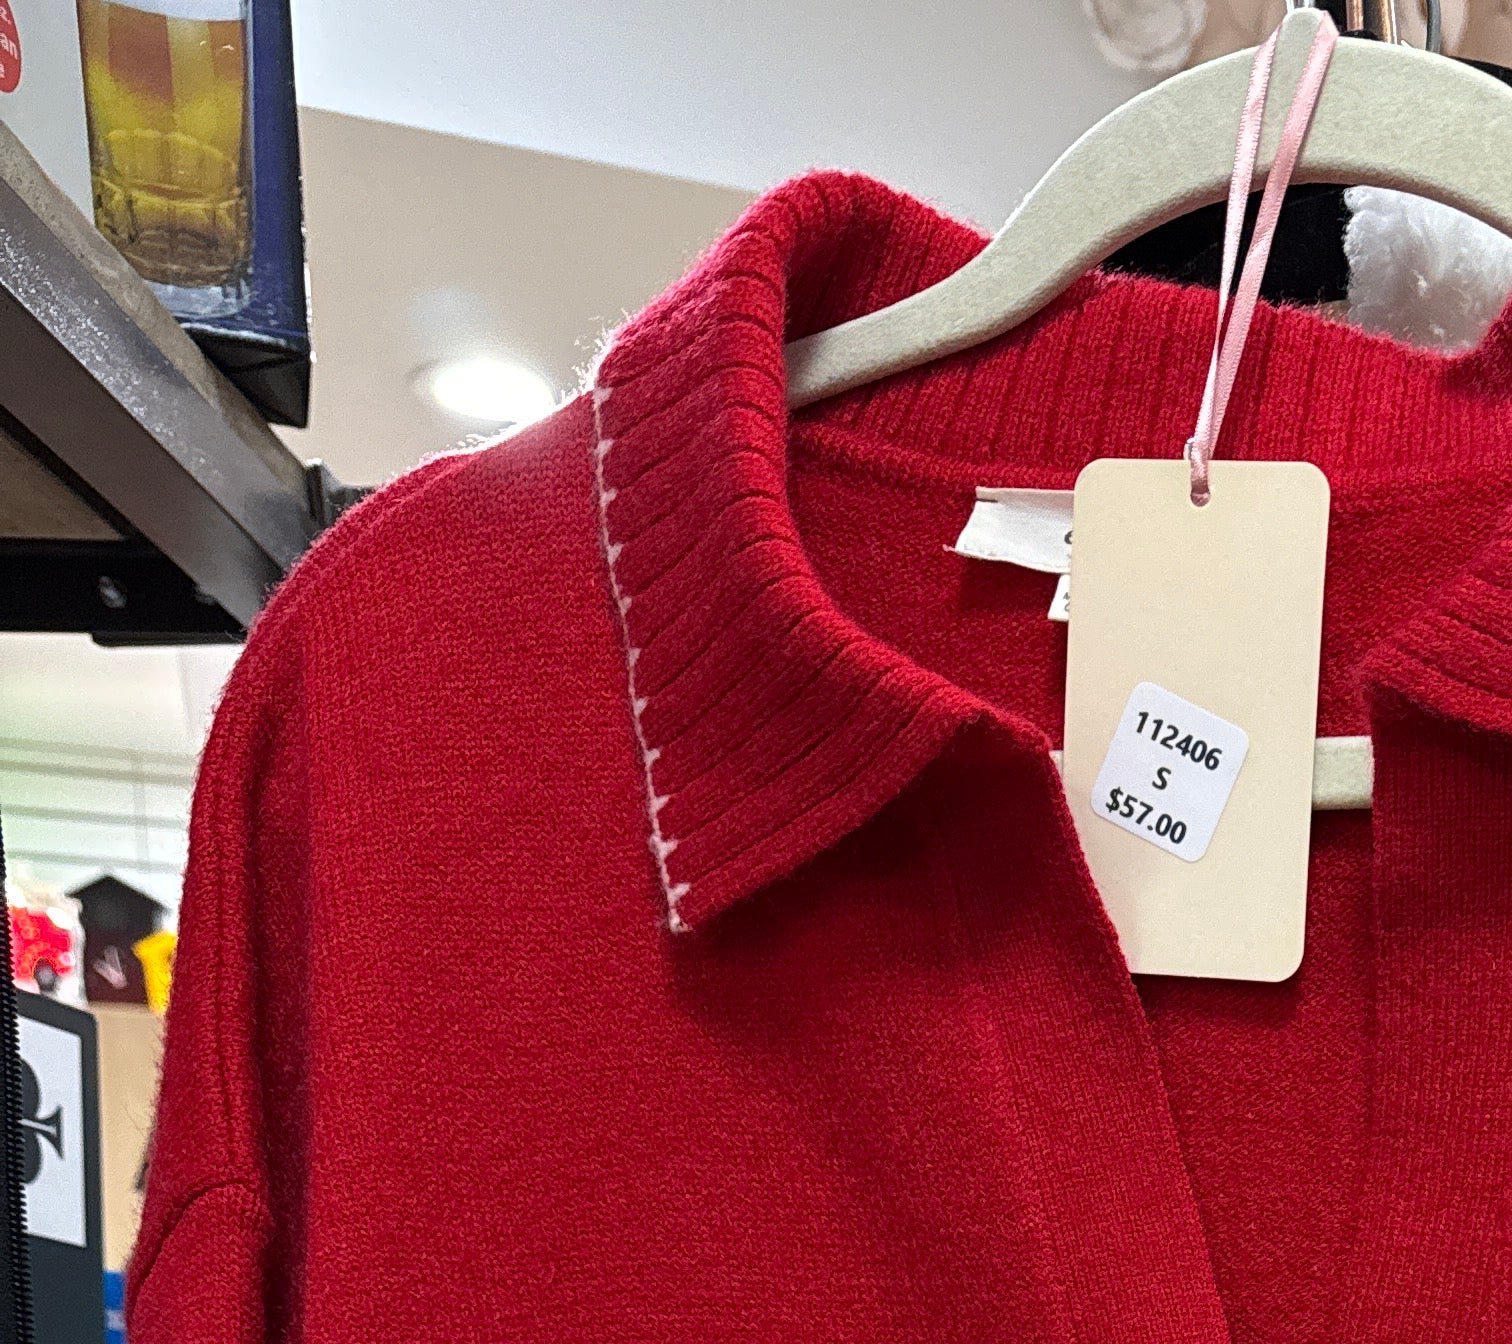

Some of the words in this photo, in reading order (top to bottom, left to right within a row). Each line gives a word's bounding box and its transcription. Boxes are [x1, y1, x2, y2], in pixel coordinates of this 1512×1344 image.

[1136, 711, 1223, 771] 112406
[1151, 766, 1172, 791] S
[1105, 786, 1188, 845] $57.00
